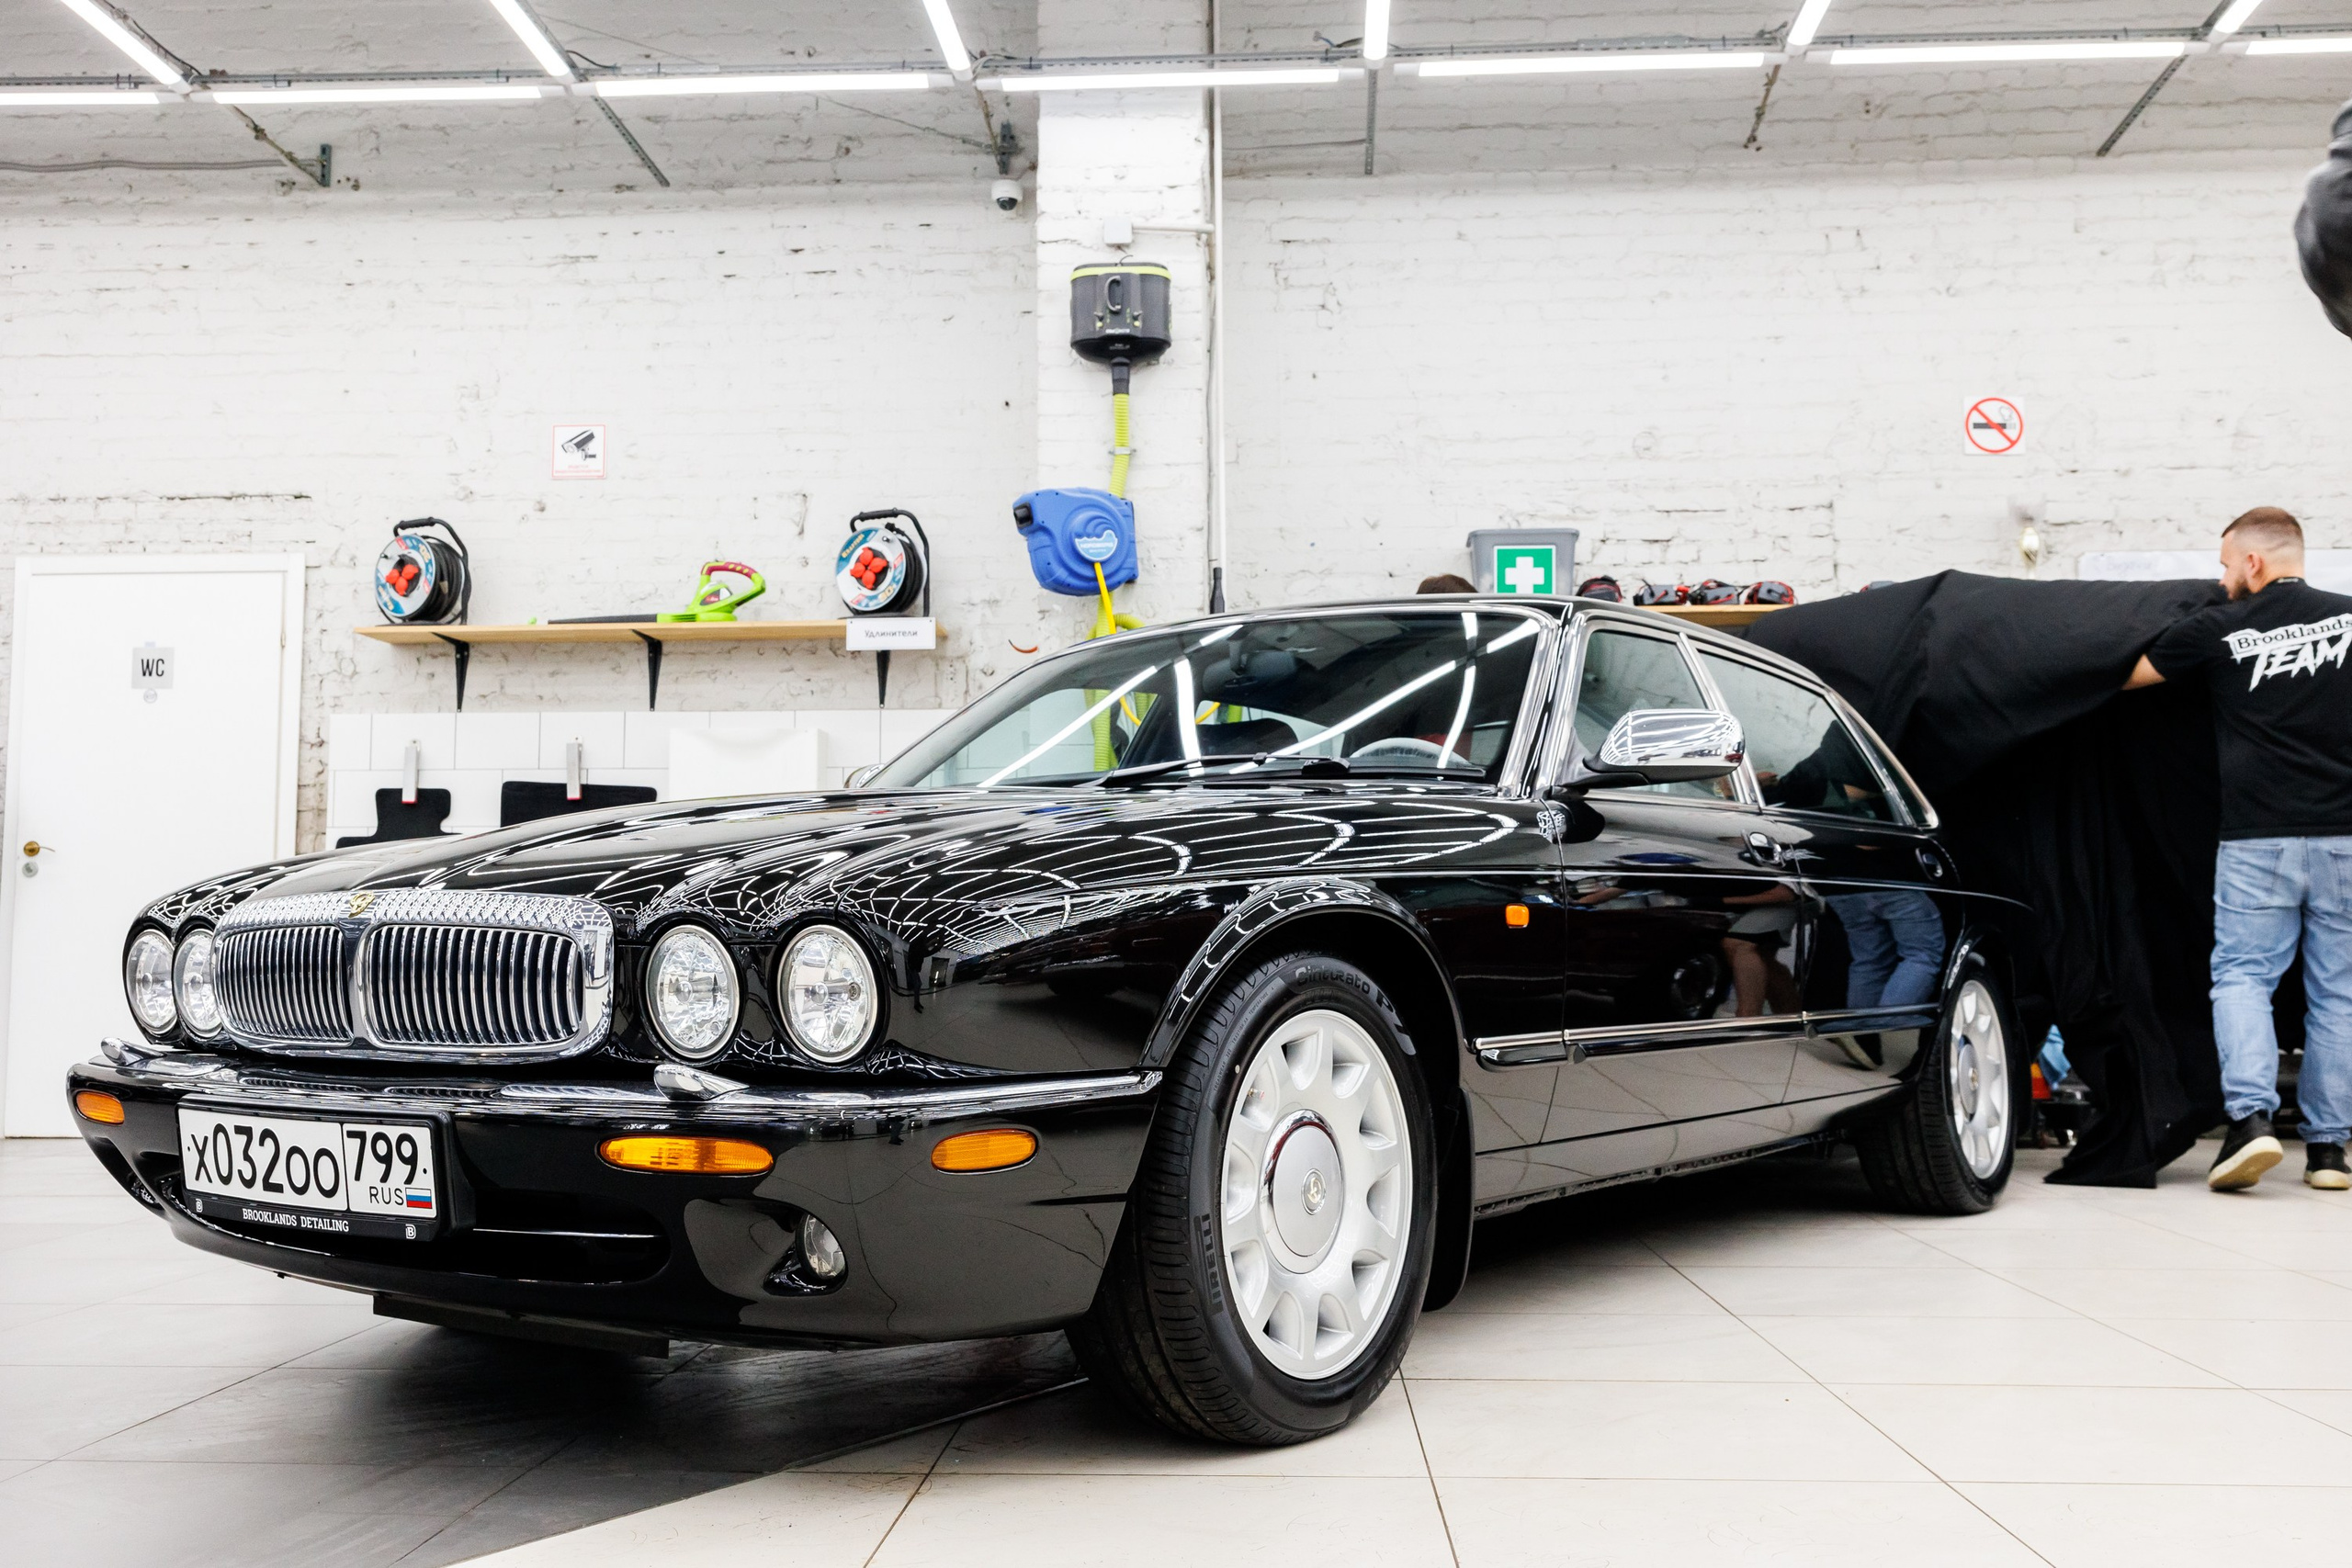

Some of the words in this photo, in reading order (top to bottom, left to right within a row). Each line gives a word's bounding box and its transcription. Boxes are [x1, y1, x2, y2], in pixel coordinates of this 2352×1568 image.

[865, 629, 918, 639] Удлинители
[2237, 619, 2352, 649] Brooklands
[141, 658, 165, 678] WC
[2248, 631, 2352, 693] TEAM
[345, 1130, 419, 1185] 799
[369, 1186, 404, 1206] RUS
[242, 1208, 298, 1227] BROOKLANDS
[300, 1218, 350, 1233] DETAILING
